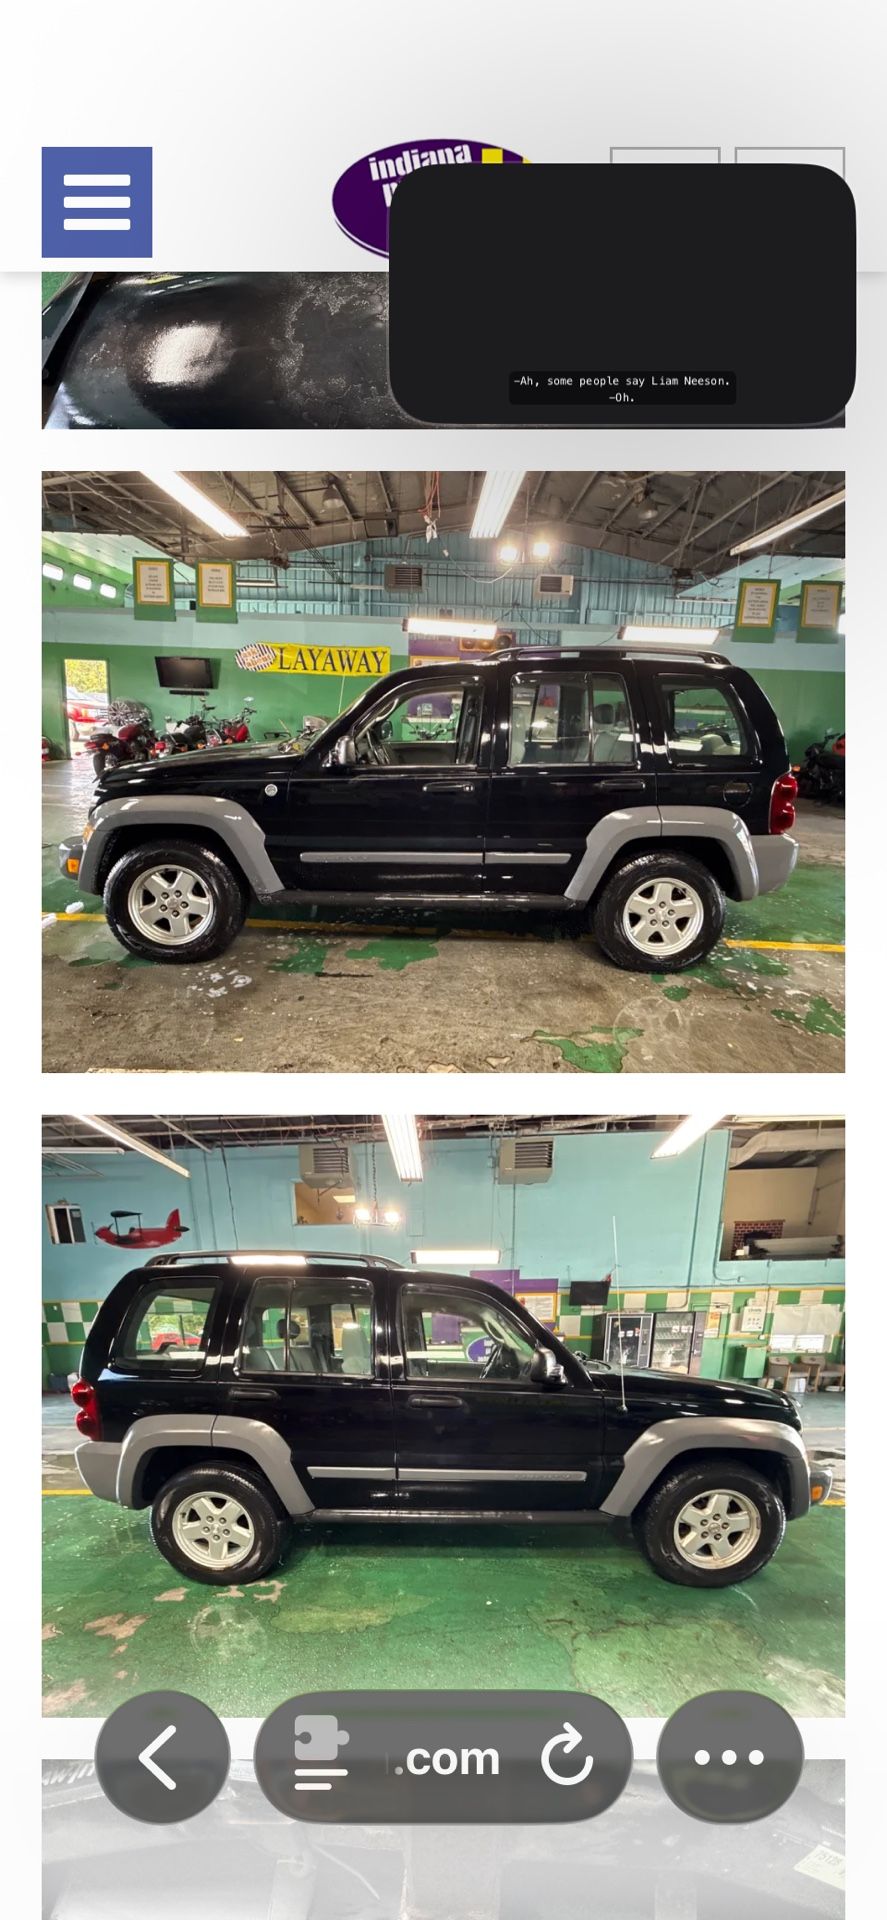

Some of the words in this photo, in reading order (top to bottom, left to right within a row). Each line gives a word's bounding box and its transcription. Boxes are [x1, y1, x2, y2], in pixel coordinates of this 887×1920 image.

[369, 144, 472, 181] indiana
[279, 647, 387, 673] LAYAWAY
[394, 1748, 499, 1775] .com
